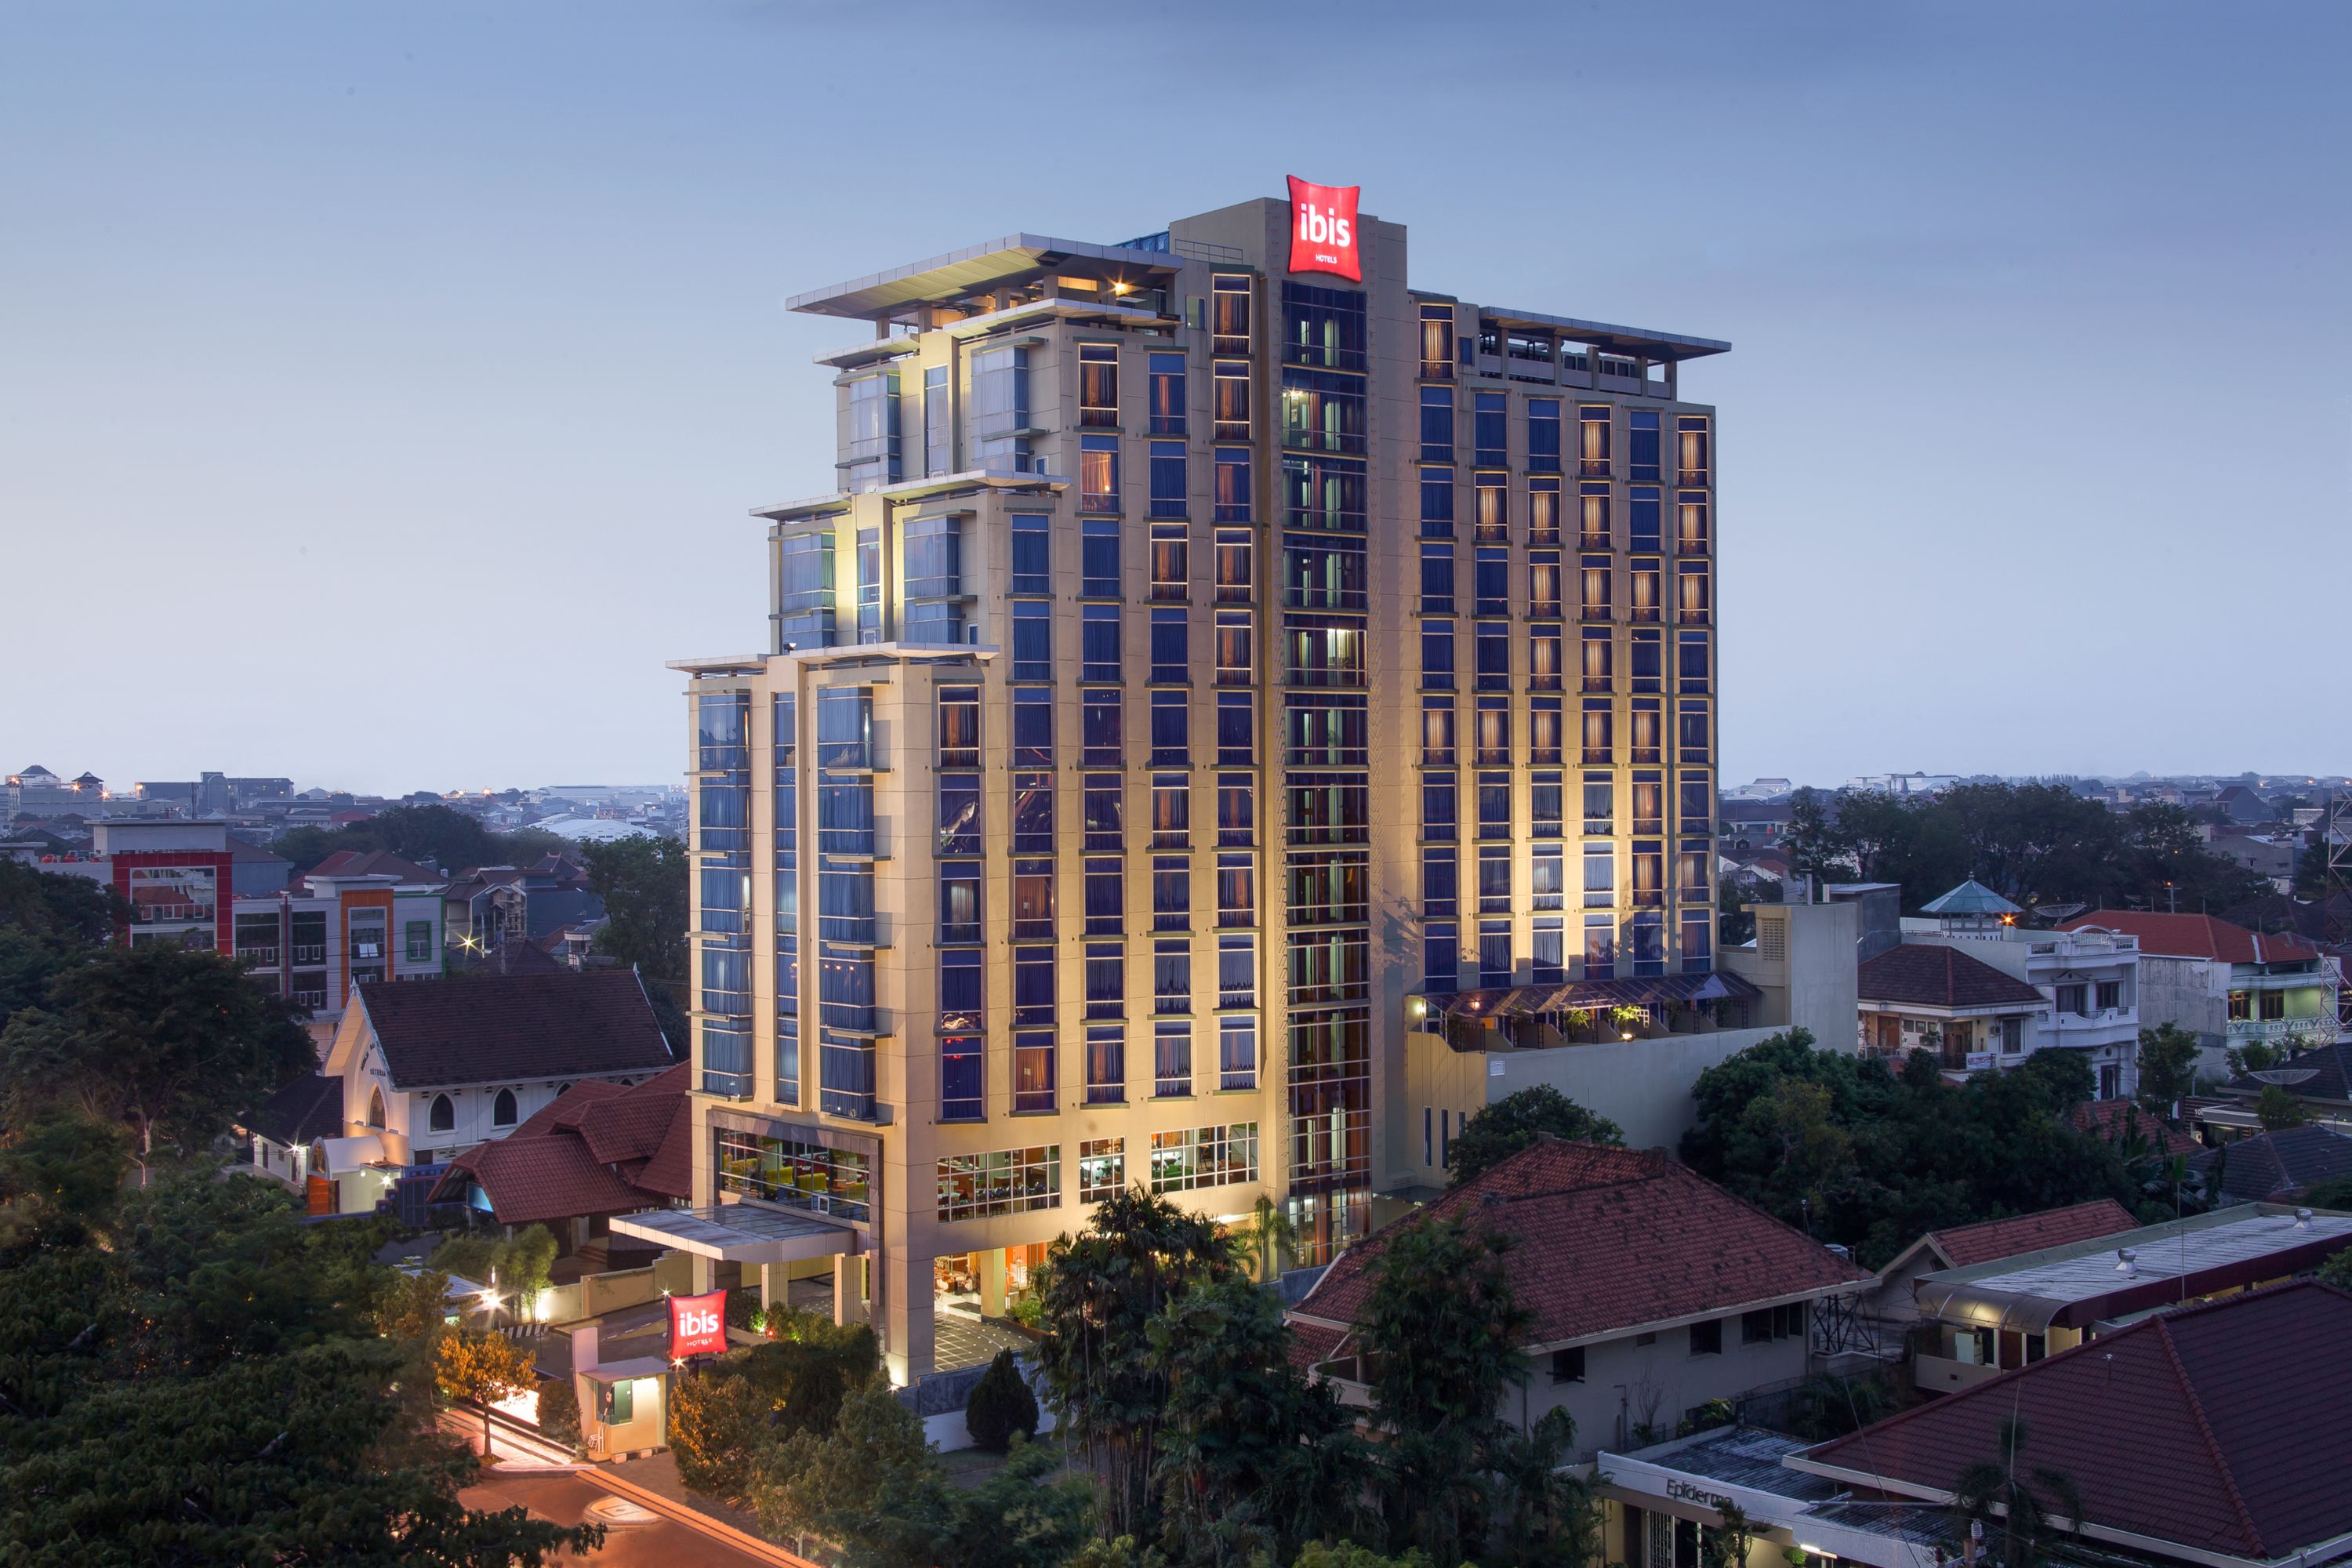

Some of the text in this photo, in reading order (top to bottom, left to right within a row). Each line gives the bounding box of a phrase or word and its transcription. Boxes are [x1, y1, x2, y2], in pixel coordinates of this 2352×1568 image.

[1301, 203, 1351, 248] ibis
[1316, 253, 1338, 264] HOTELS
[680, 1309, 719, 1338] ibis
[687, 1337, 713, 1348] HOTELS
[1666, 1479, 1734, 1508] Epiderma
